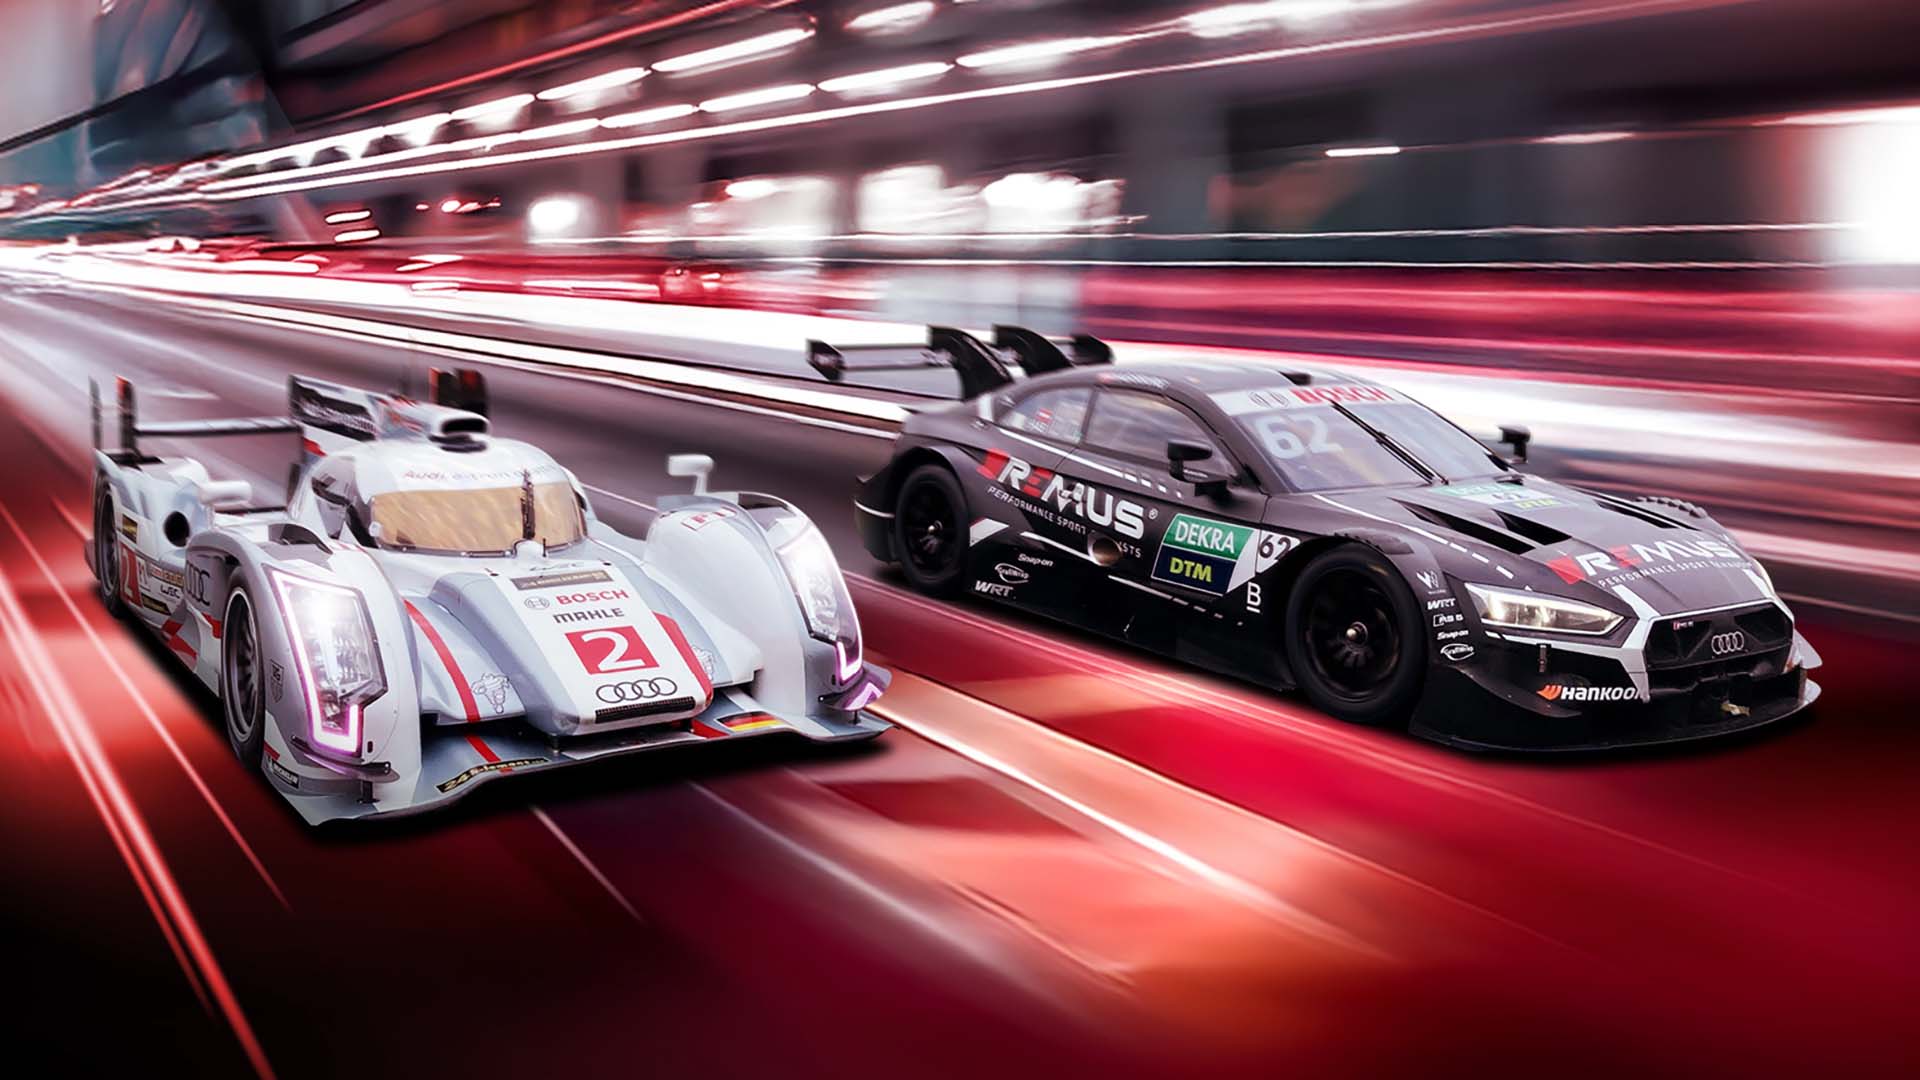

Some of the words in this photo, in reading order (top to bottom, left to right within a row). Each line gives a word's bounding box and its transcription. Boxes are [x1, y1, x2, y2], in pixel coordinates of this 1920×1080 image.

[1289, 386, 1394, 405] BOSCH
[1254, 413, 1344, 460] 62
[986, 486, 1054, 524] PERFORMANCE
[1056, 514, 1087, 536] SPORT
[1173, 520, 1236, 554] DEKRA
[1258, 534, 1292, 561] 62
[1017, 553, 1054, 567] Snap-on
[1169, 556, 1212, 583] DTM
[1576, 540, 1741, 577] REMUS
[975, 580, 1014, 597] WRT
[1597, 563, 1678, 590] PERFORMANCE
[1676, 560, 1712, 572] SPORT
[556, 589, 630, 606] BOSCH
[1246, 581, 1262, 608] B
[1427, 598, 1456, 611] WRT
[552, 607, 625, 624] MAHLE
[581, 630, 647, 673] 2
